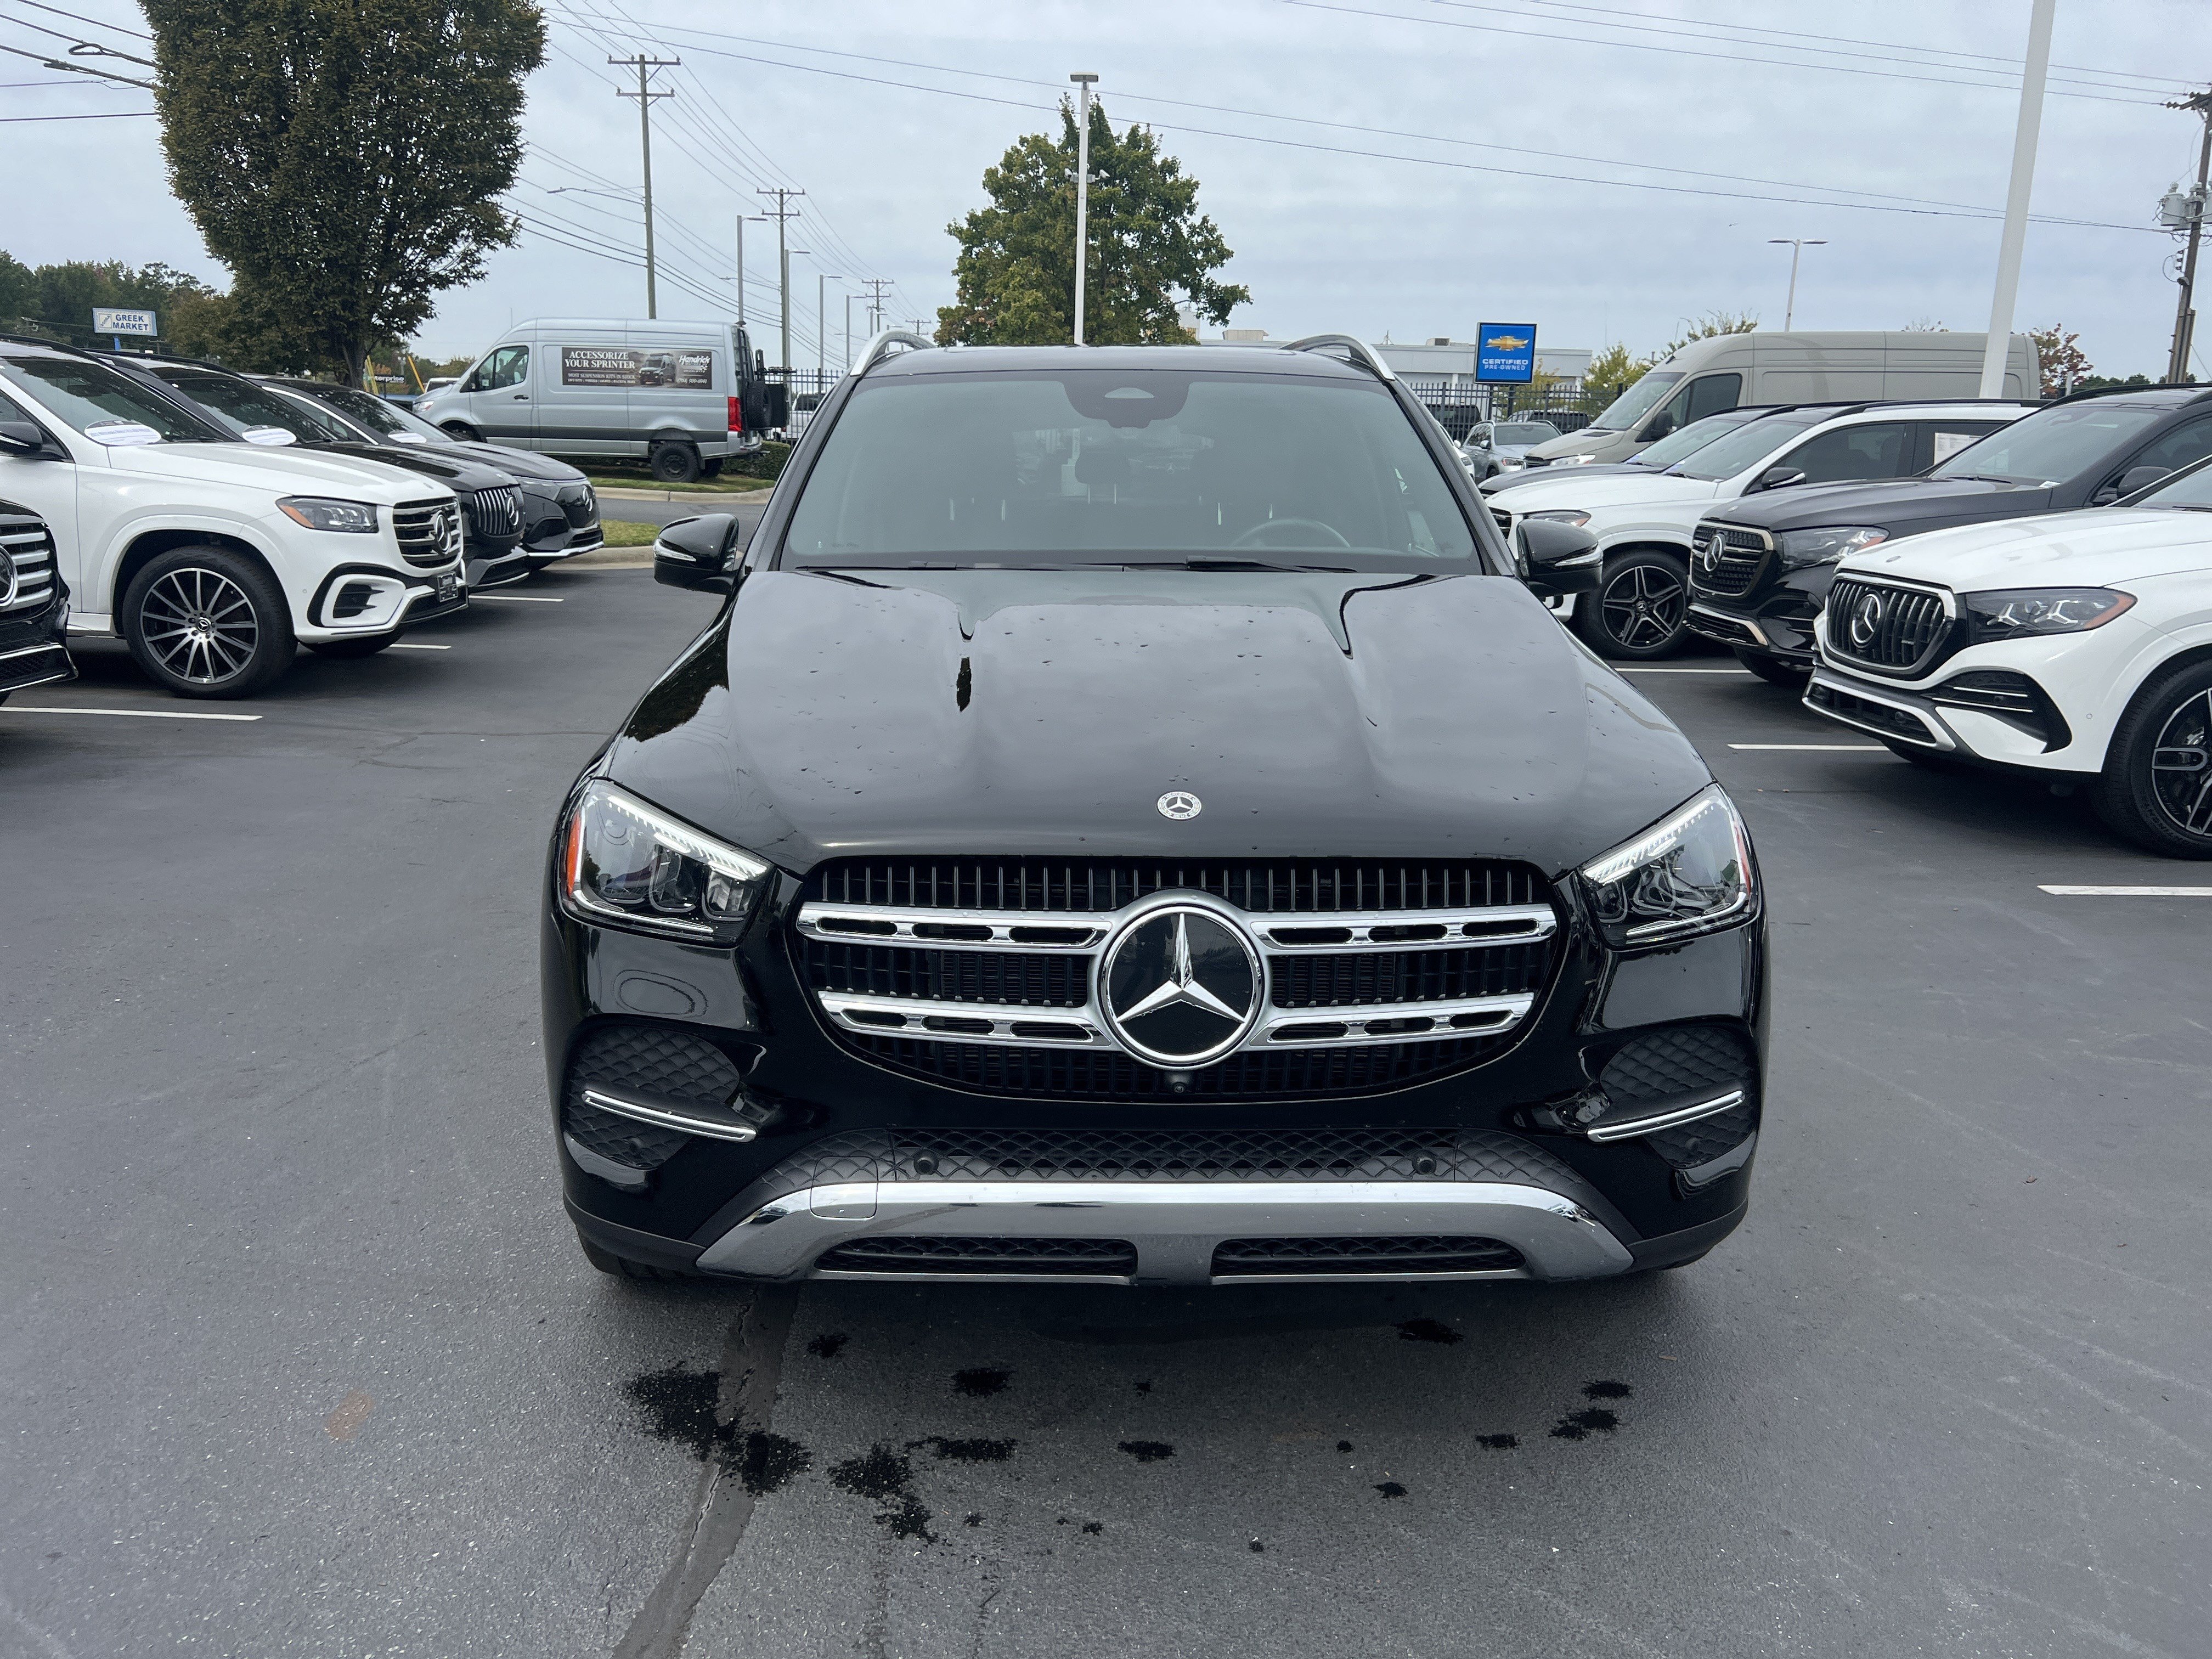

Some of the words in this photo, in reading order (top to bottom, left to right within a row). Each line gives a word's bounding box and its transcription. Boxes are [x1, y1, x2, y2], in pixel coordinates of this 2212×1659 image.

[112, 321, 149, 331] MARKET
[569, 351, 629, 360] ACCESSORIZE
[679, 355, 711, 365] Hendrick
[565, 358, 590, 368] YOUR
[591, 359, 636, 369] SPRINTER
